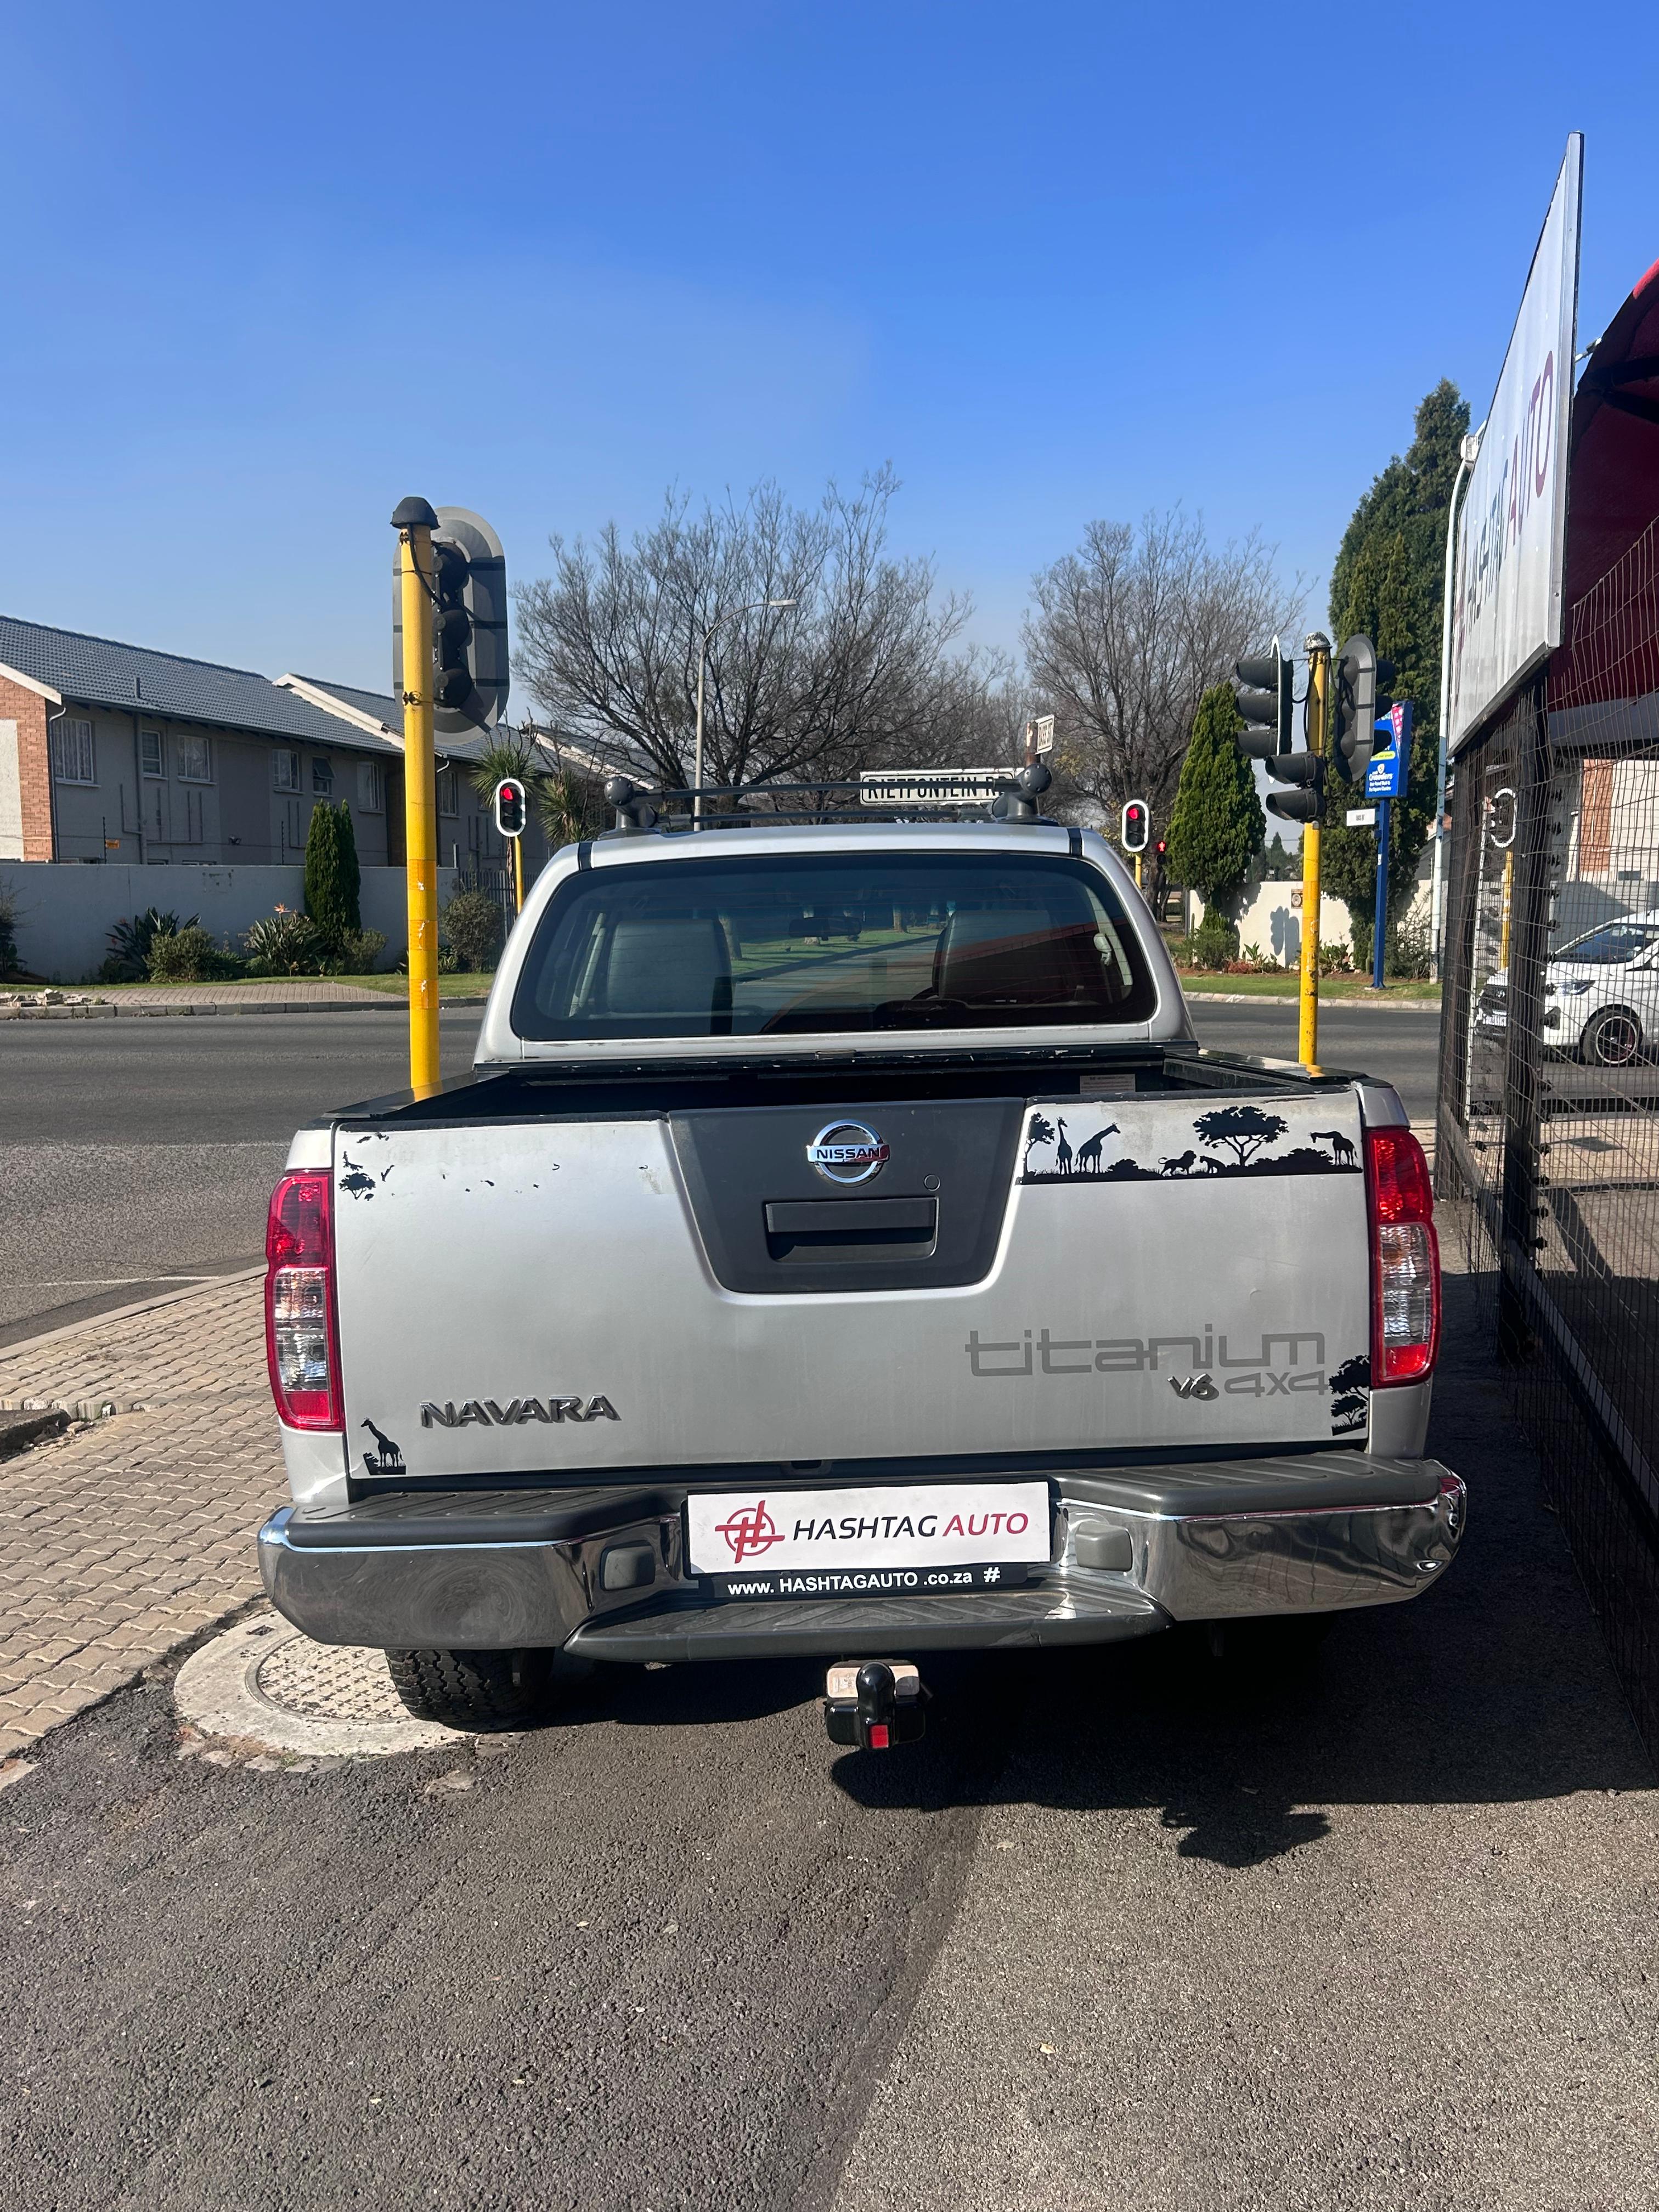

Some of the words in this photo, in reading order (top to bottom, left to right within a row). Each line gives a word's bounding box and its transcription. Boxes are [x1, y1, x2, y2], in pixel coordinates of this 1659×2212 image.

[1505, 351, 1553, 560] AUTO
[868, 776, 977, 799] RIETFONTEIN
[816, 1147, 880, 1159] NISSAN
[964, 1323, 1325, 1377] titanium
[1167, 1373, 1219, 1401] V6
[419, 1394, 622, 1428] NAVARA
[793, 1515, 938, 1541] HASHTAG
[942, 1513, 1029, 1537] AUTO
[780, 1572, 918, 1593] HASHTAGAUTO
[923, 1570, 973, 1586] .co.za
